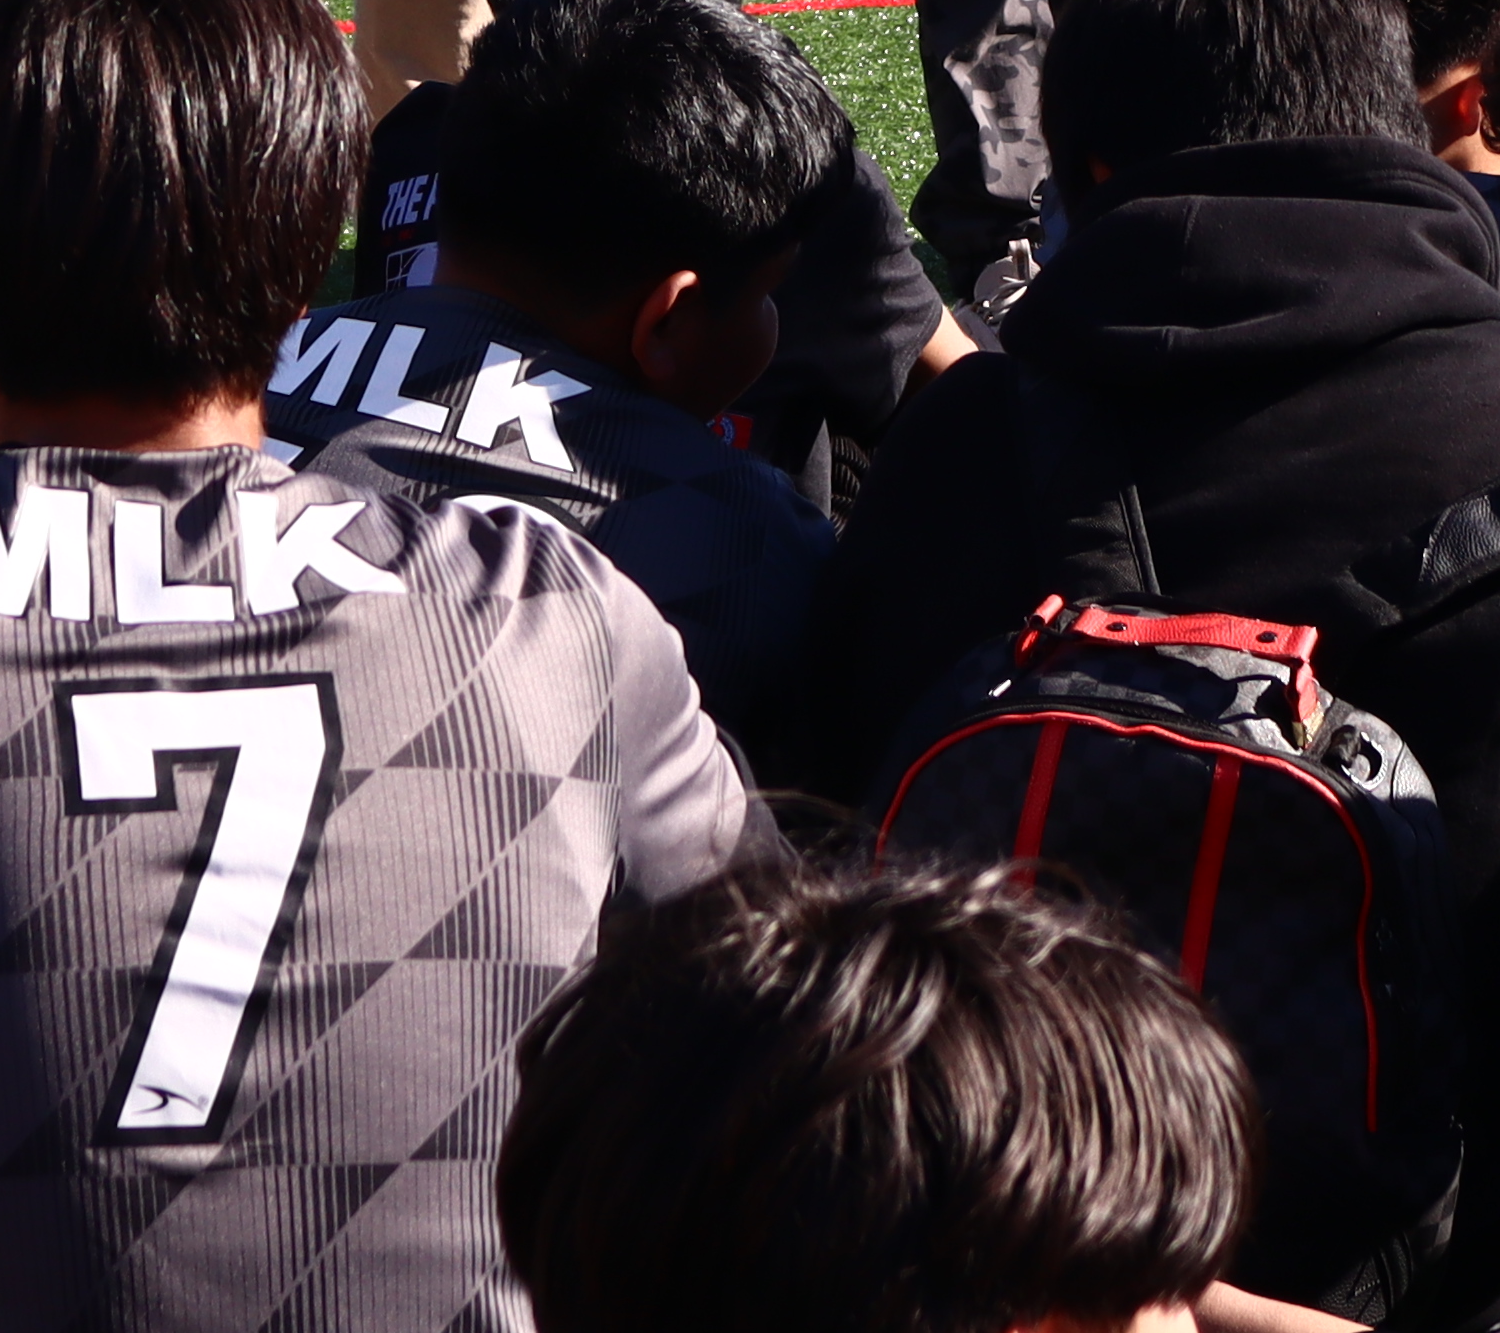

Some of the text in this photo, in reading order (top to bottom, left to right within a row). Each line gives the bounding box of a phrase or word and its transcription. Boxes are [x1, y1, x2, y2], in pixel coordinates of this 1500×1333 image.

[382, 174, 430, 232] THE
[267, 316, 593, 473] MLK
[60, 675, 338, 1141] 7
